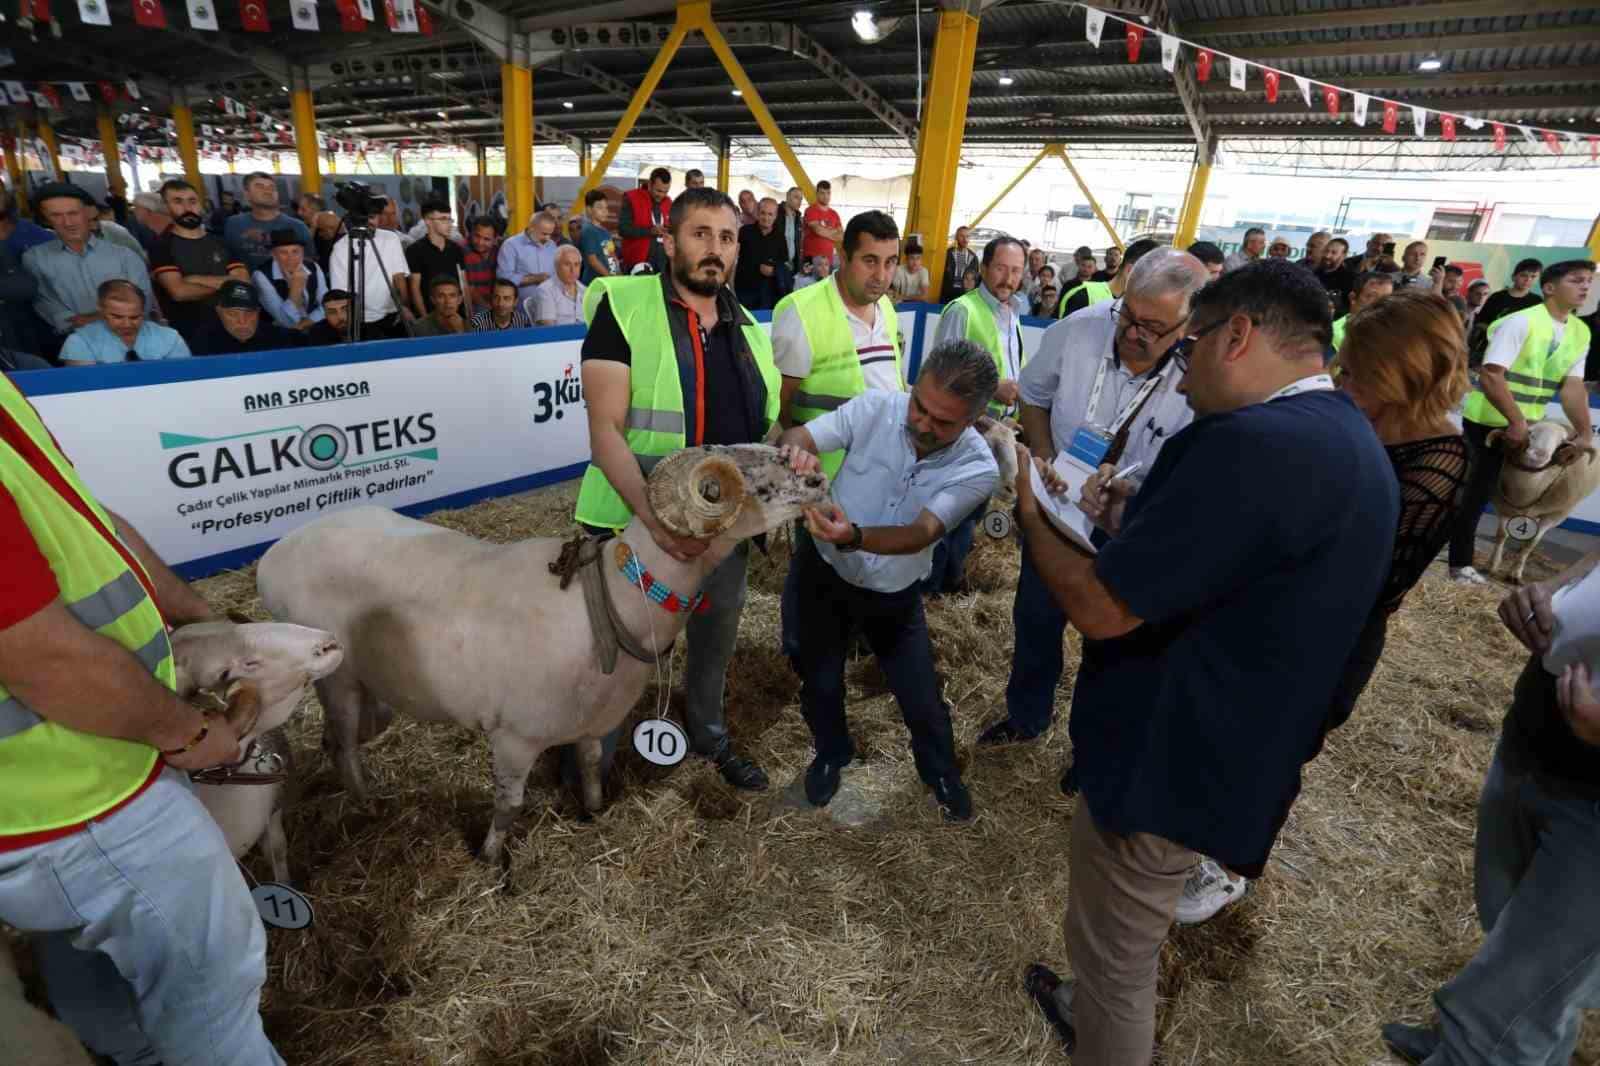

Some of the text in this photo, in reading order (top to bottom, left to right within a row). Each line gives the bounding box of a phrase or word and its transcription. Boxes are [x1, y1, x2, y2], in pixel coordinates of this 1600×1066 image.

[244, 381, 371, 411] ANA SPONSOR
[167, 412, 437, 488] GALKOTEKS
[176, 499, 213, 517] Çadır
[215, 490, 249, 509] Çelik
[249, 482, 291, 499] Yapılar
[293, 471, 343, 490] Mimarlık
[344, 465, 373, 480] Proje
[373, 460, 393, 474] Ltd.
[315, 486, 362, 509] Çiftlik
[991, 517, 1002, 533] 8
[1515, 521, 1529, 536] 4
[642, 727, 678, 757] 10
[263, 893, 297, 922] 11
